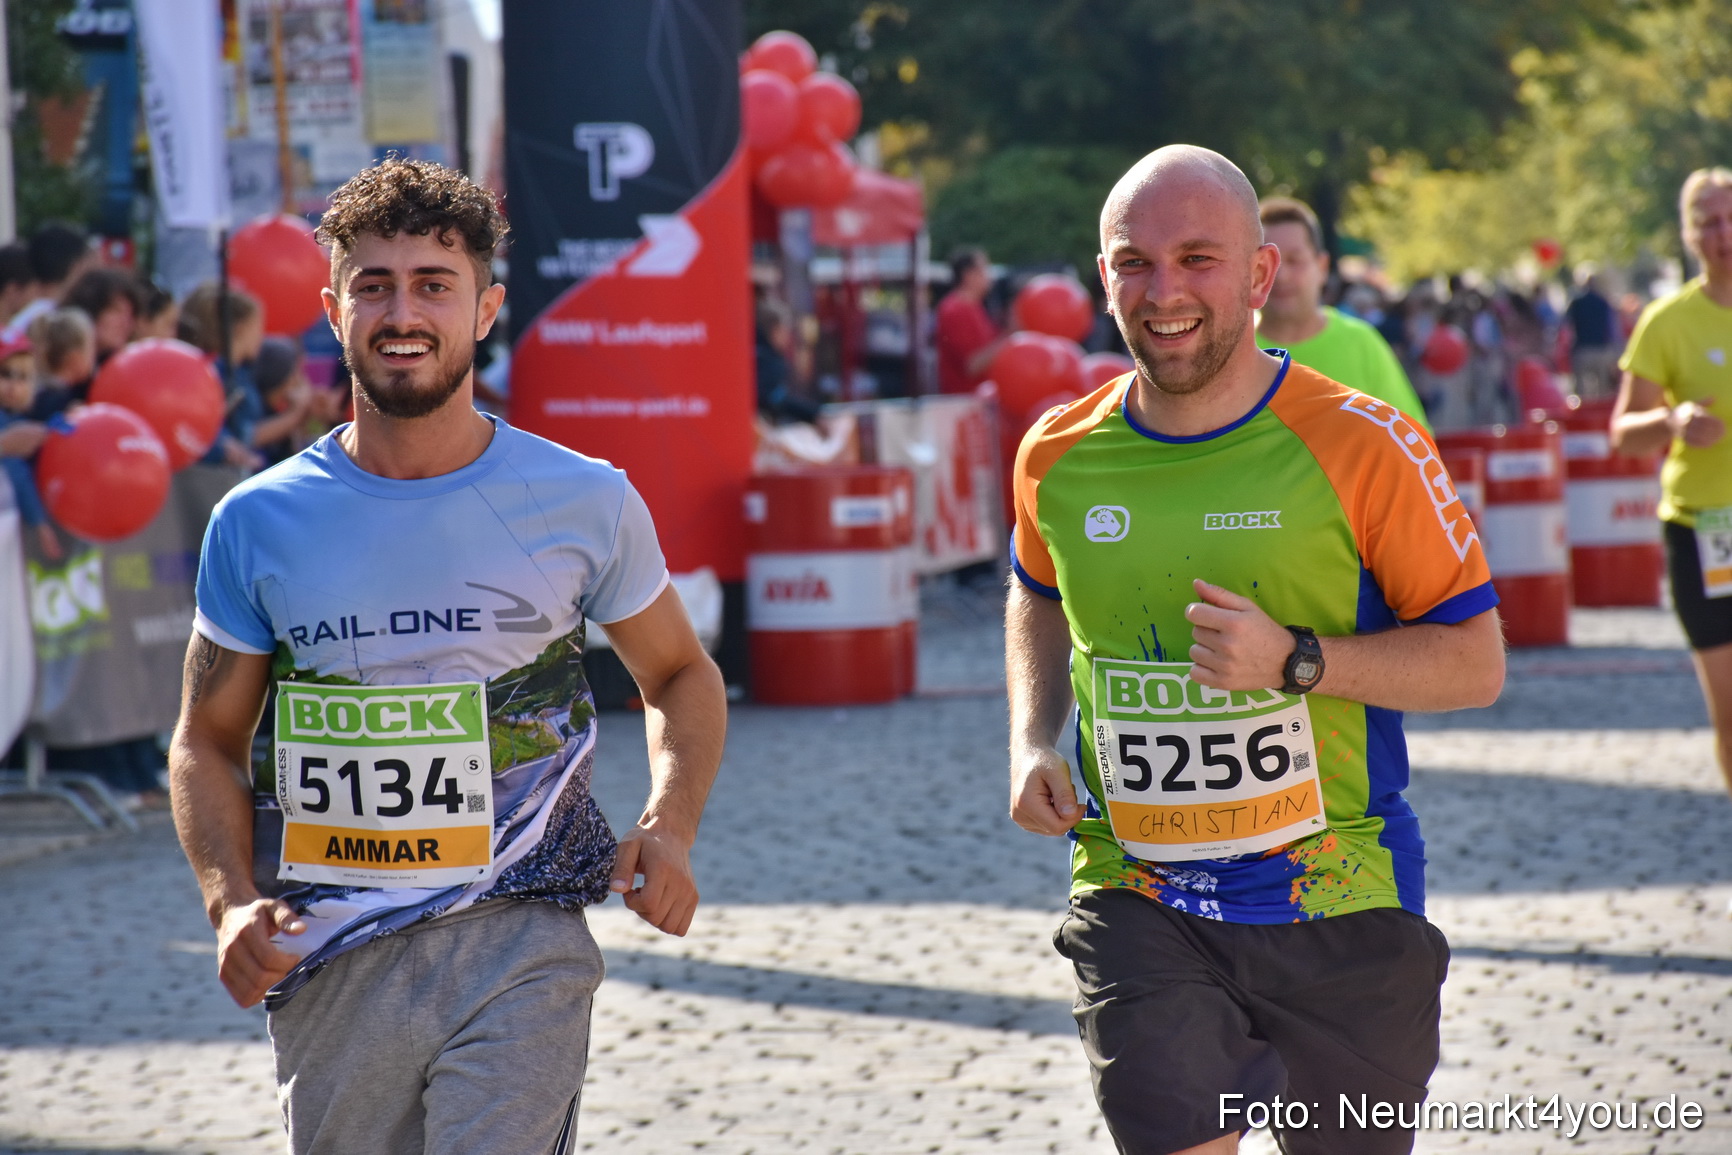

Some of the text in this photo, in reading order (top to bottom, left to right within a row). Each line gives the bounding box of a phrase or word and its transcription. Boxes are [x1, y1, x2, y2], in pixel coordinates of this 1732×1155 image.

[1340, 393, 1480, 563] BOCK
[1204, 511, 1282, 530] BOCK
[288, 692, 467, 739] BOCK
[1118, 724, 1290, 792] 5256
[300, 756, 464, 817] 5134
[1139, 792, 1308, 837] CHRISTIAN
[325, 836, 441, 863] AMMAR
